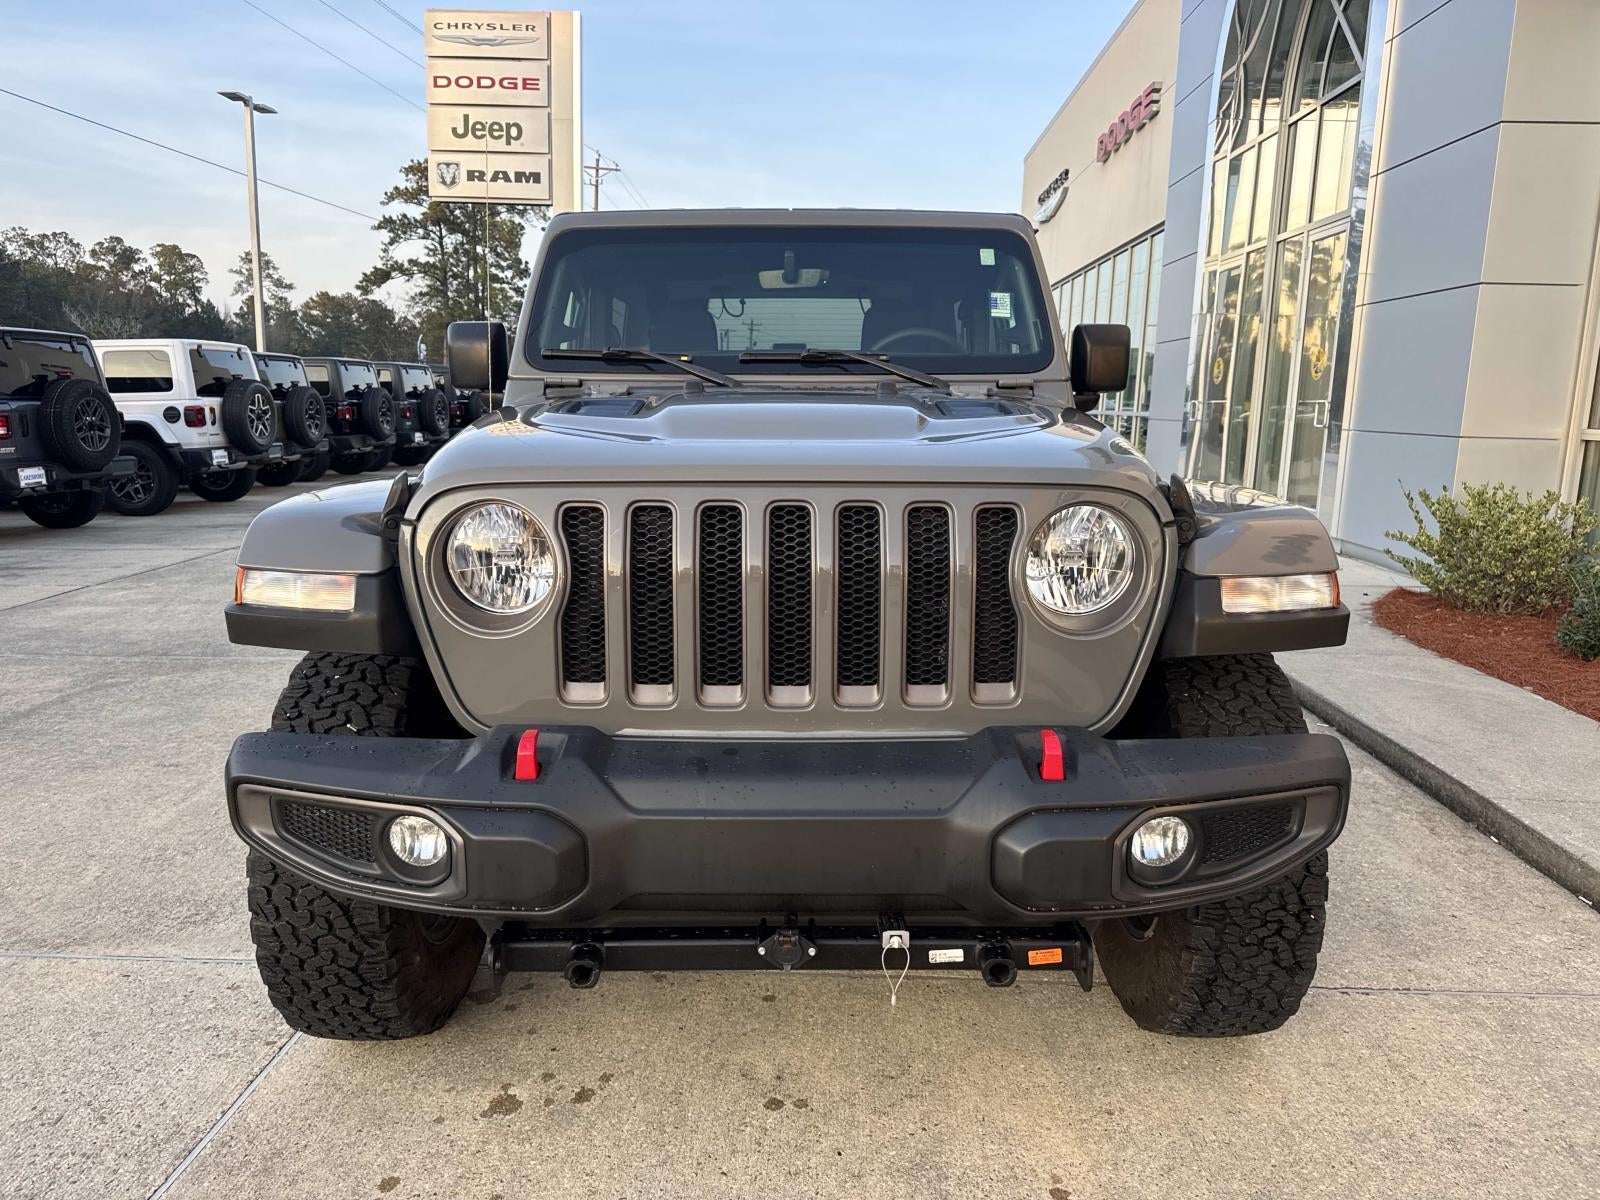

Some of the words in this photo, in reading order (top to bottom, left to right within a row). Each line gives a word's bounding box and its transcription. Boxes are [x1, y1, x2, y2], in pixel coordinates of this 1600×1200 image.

[433, 22, 537, 32] CHRYSLER
[433, 75, 540, 91] DODGE
[451, 113, 523, 146] Jeep
[1096, 81, 1163, 163] DODGE
[466, 169, 541, 185] RAM
